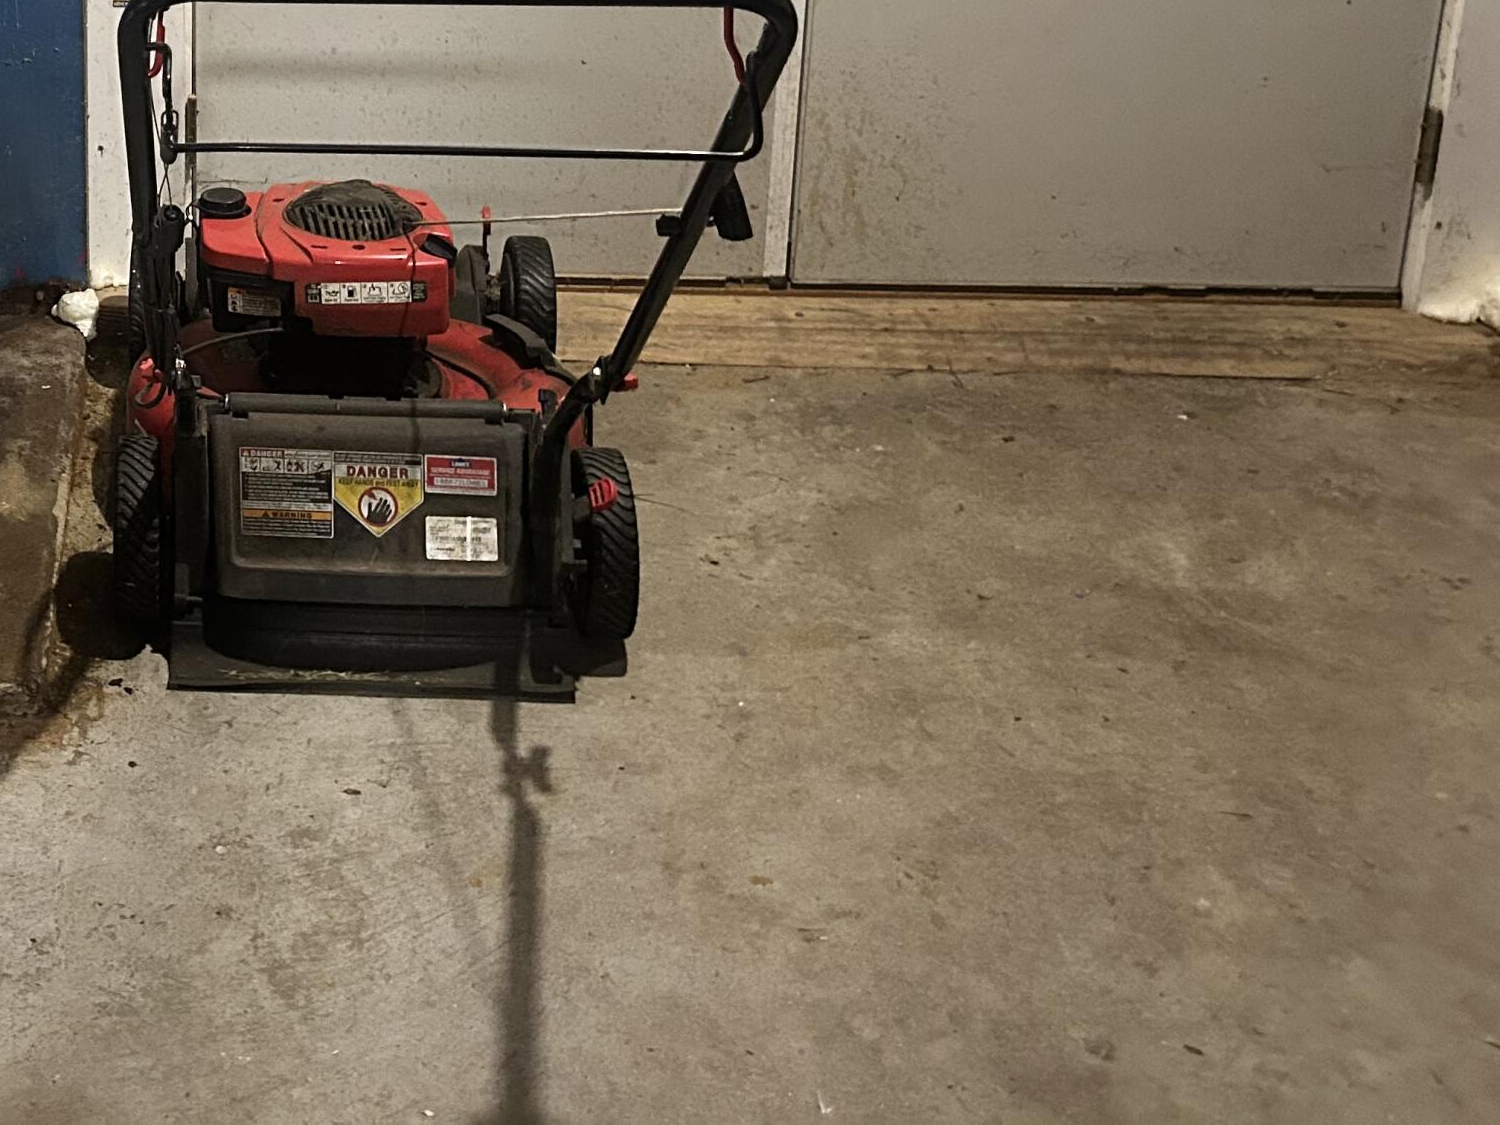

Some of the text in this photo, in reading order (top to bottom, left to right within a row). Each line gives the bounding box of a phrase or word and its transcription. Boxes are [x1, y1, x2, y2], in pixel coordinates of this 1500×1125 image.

[250, 450, 283, 458] DANGER
[346, 465, 409, 479] DANGER
[271, 511, 313, 519] WARNING
